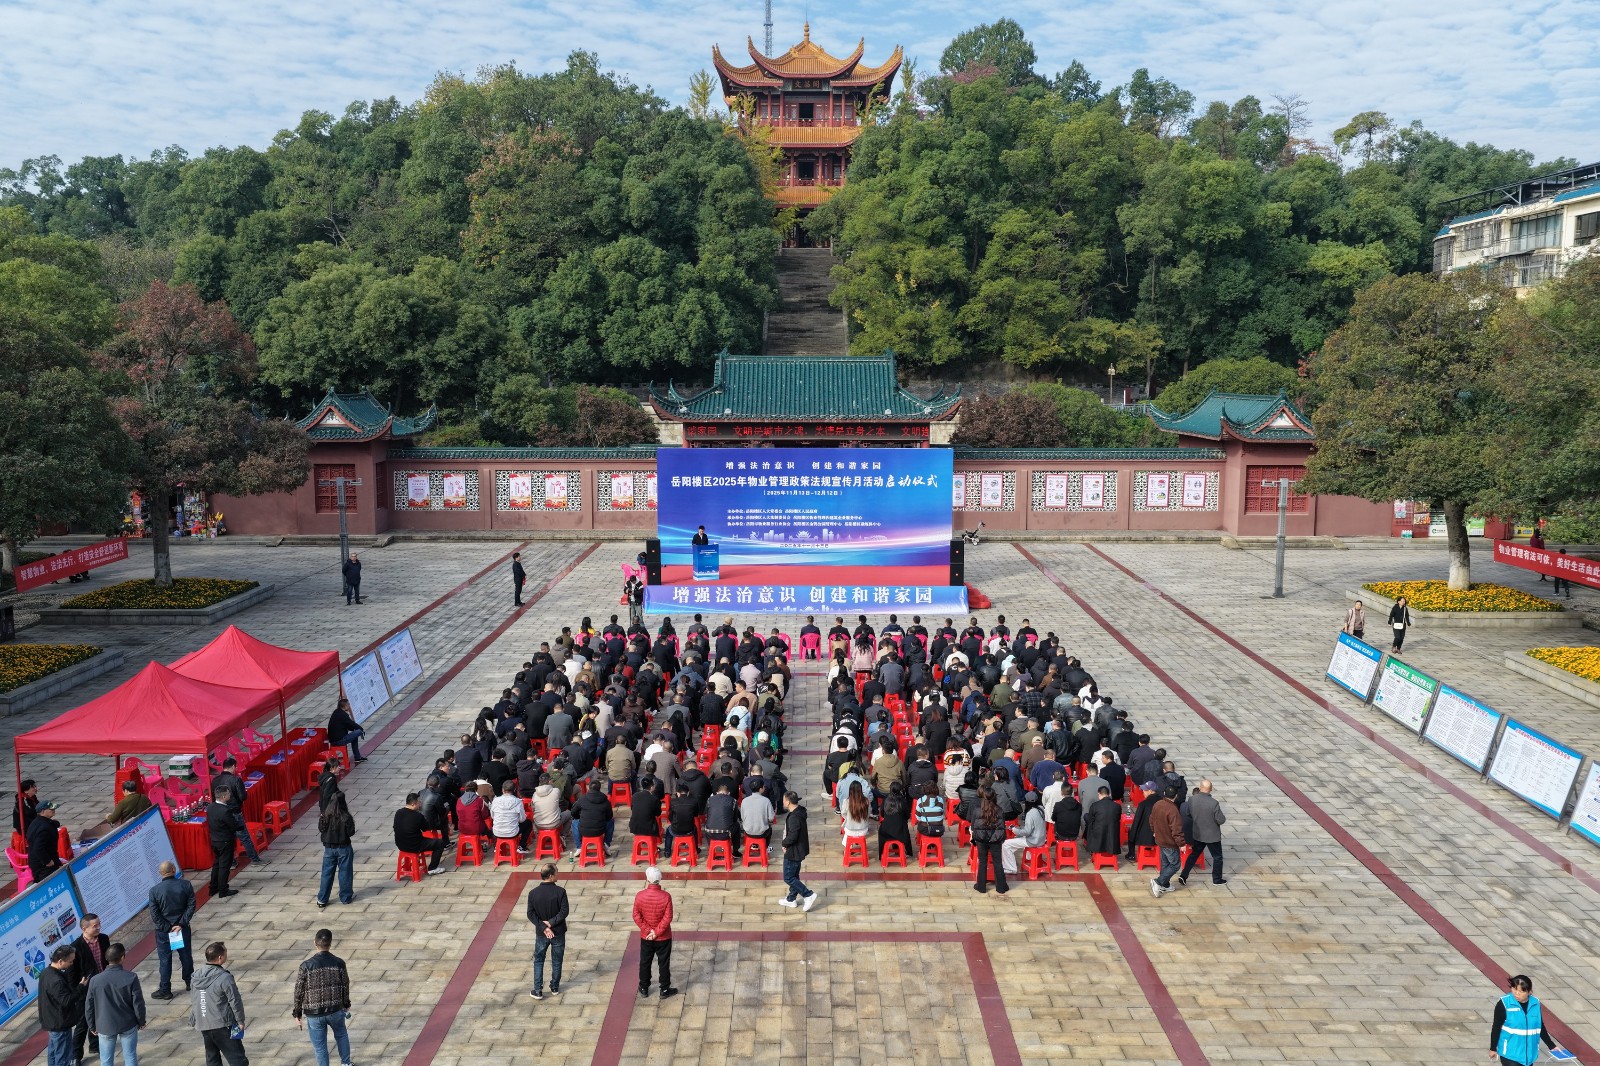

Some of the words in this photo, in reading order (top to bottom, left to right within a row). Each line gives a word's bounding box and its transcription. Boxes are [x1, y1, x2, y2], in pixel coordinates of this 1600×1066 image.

[725, 461, 795, 470] 增强法治意识
[811, 461, 881, 470] 创建和谐家园
[672, 586, 796, 604] 增强法治意识
[809, 586, 933, 604] 创建和谐家园
